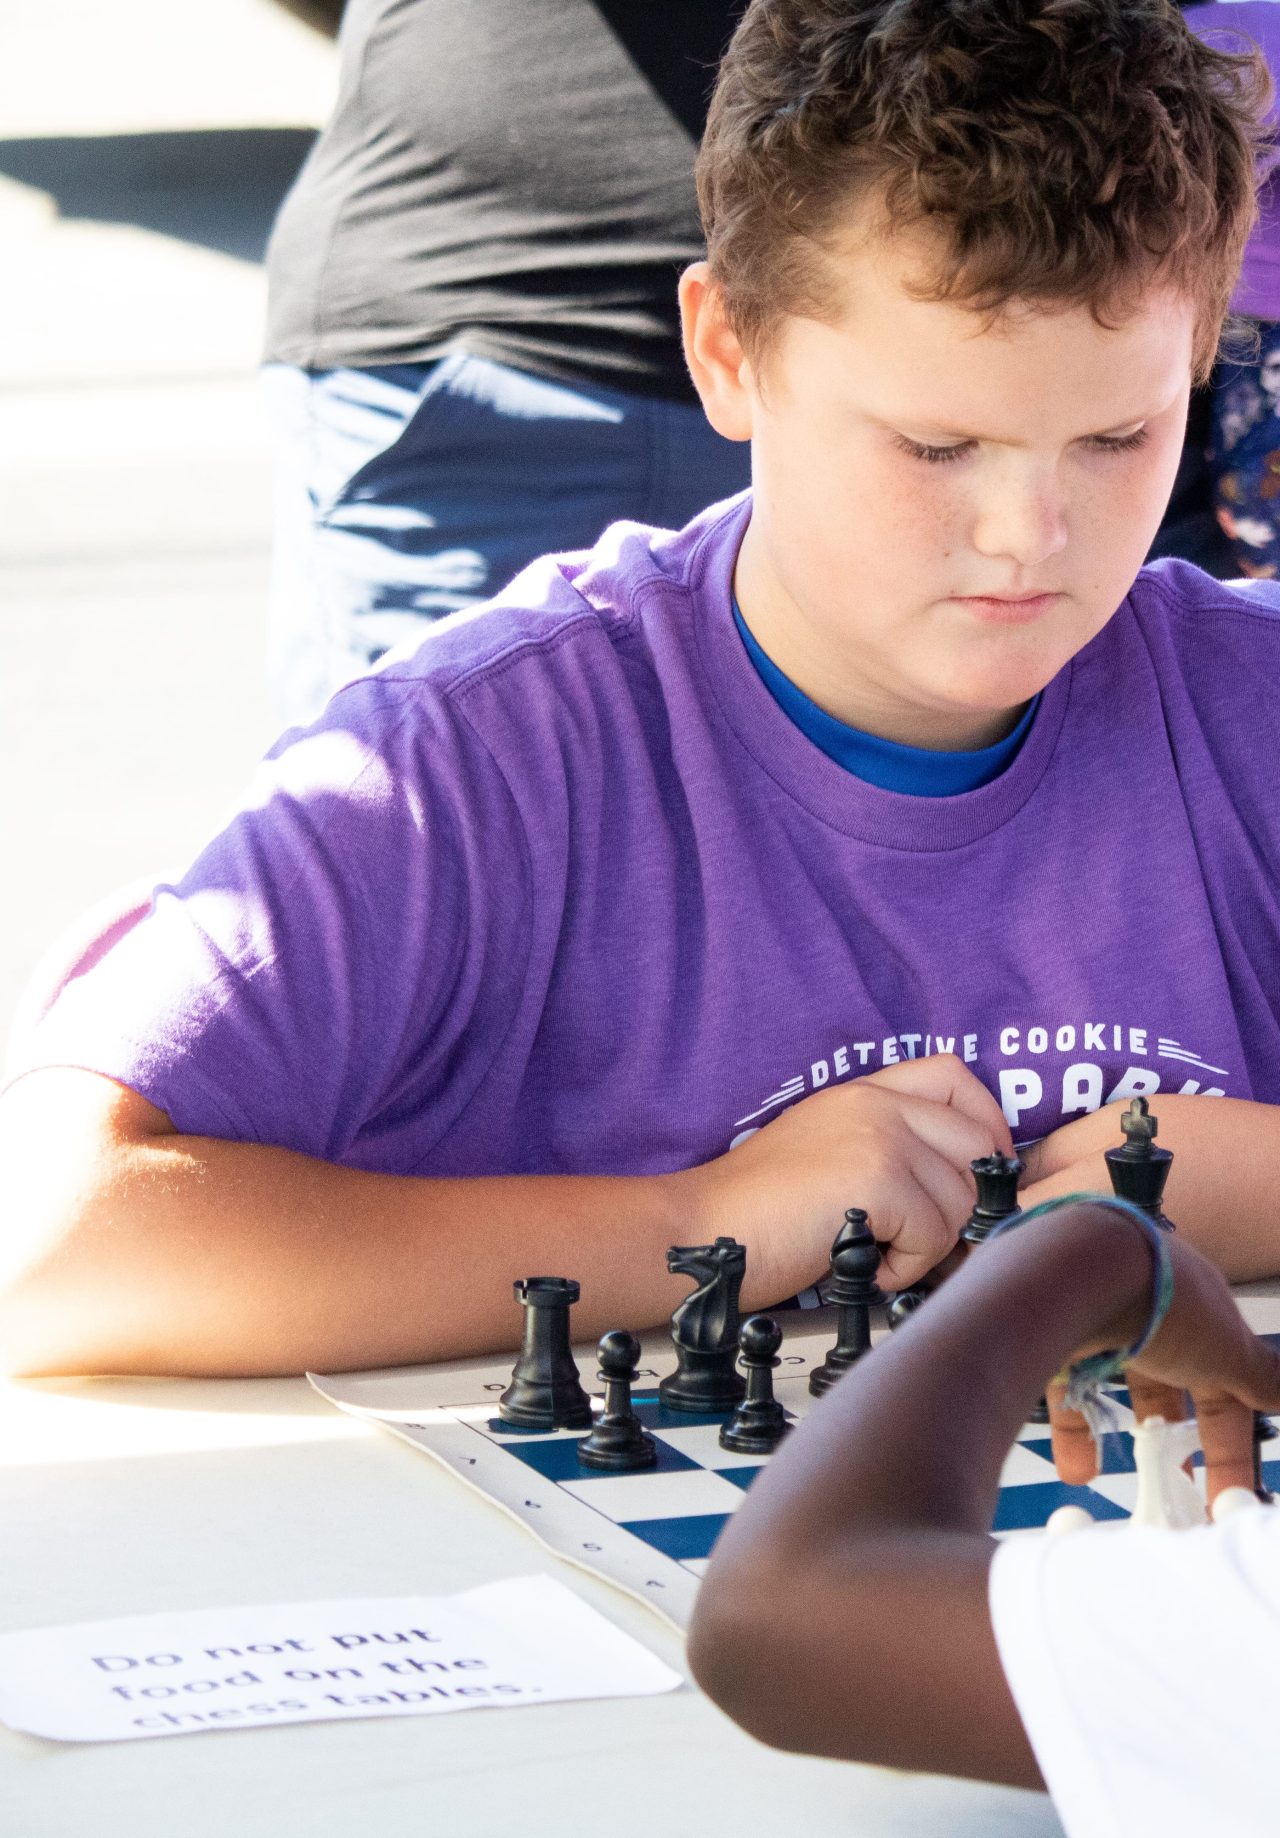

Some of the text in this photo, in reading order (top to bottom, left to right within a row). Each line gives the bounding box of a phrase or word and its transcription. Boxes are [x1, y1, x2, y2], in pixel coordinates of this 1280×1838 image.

[1000, 1022, 1148, 1056] COOKIE
[91, 1628, 441, 1673] Do not put
[111, 1657, 489, 1702] food on the
[132, 1698, 310, 1729] chess
